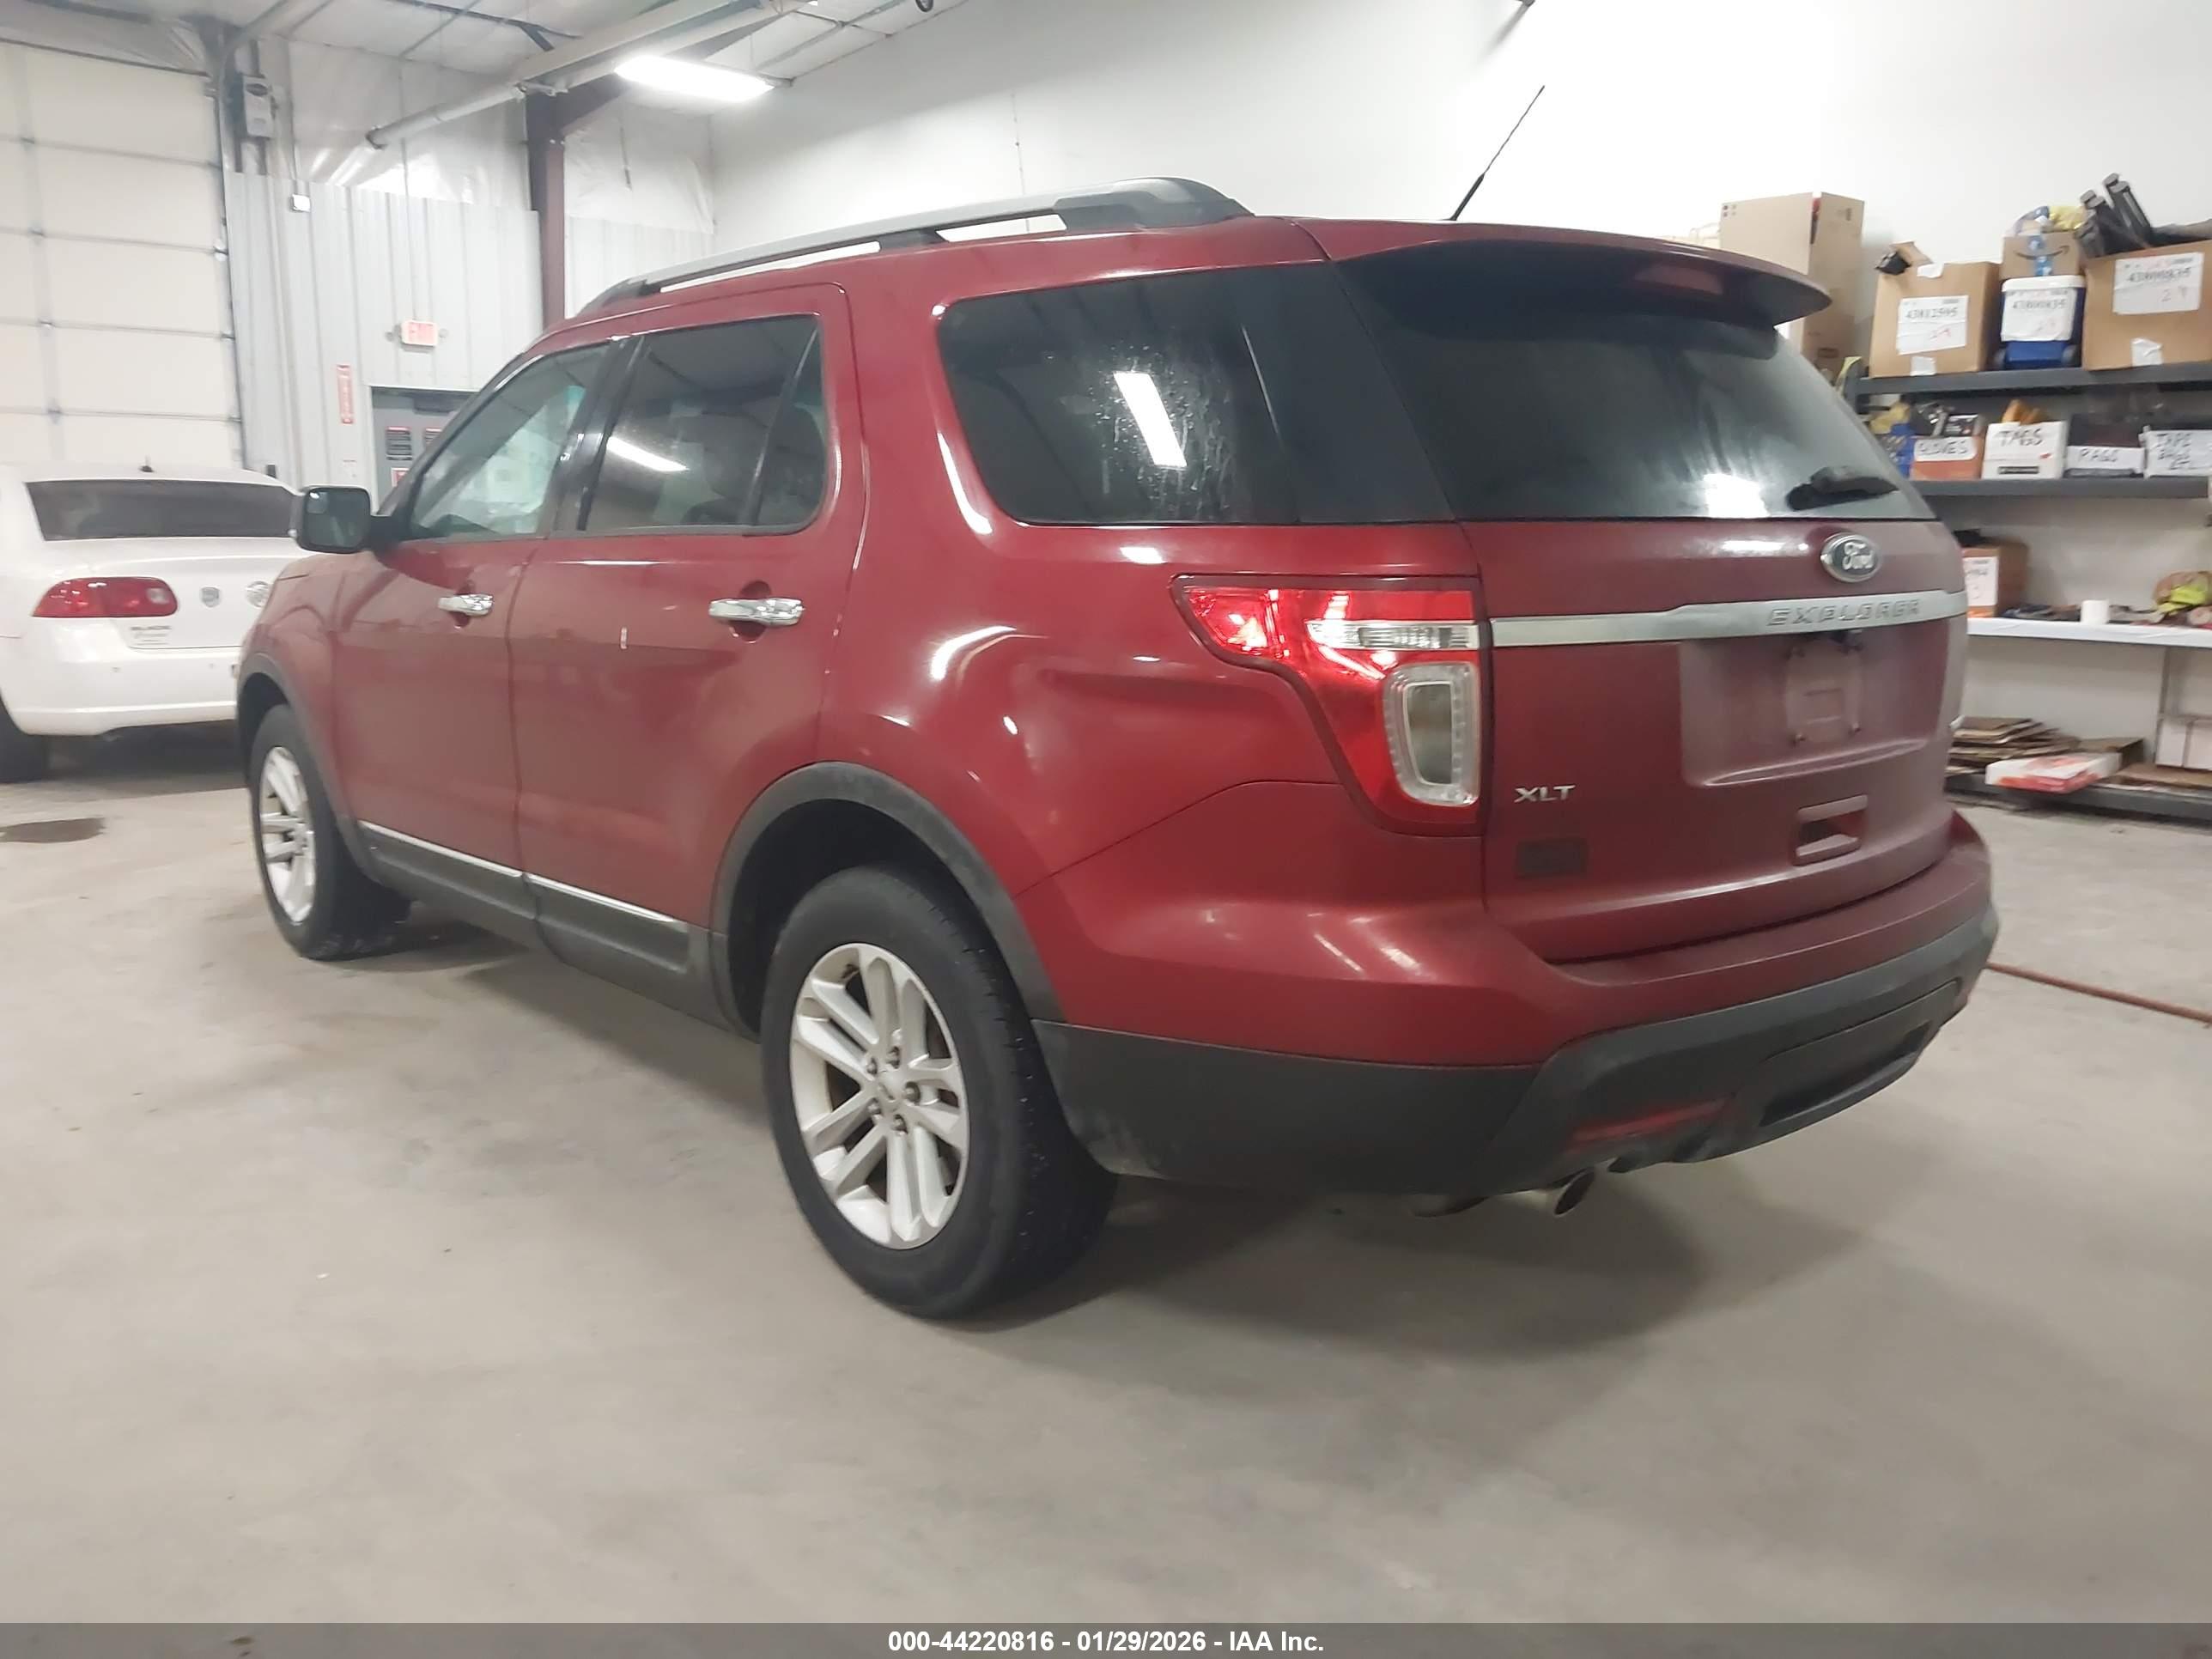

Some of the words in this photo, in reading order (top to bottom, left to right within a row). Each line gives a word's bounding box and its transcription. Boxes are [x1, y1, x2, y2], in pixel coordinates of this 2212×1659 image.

[1842, 541, 1875, 570] Ford
[1766, 599, 1921, 626] EXPLORER
[1514, 784, 1577, 803] XLT
